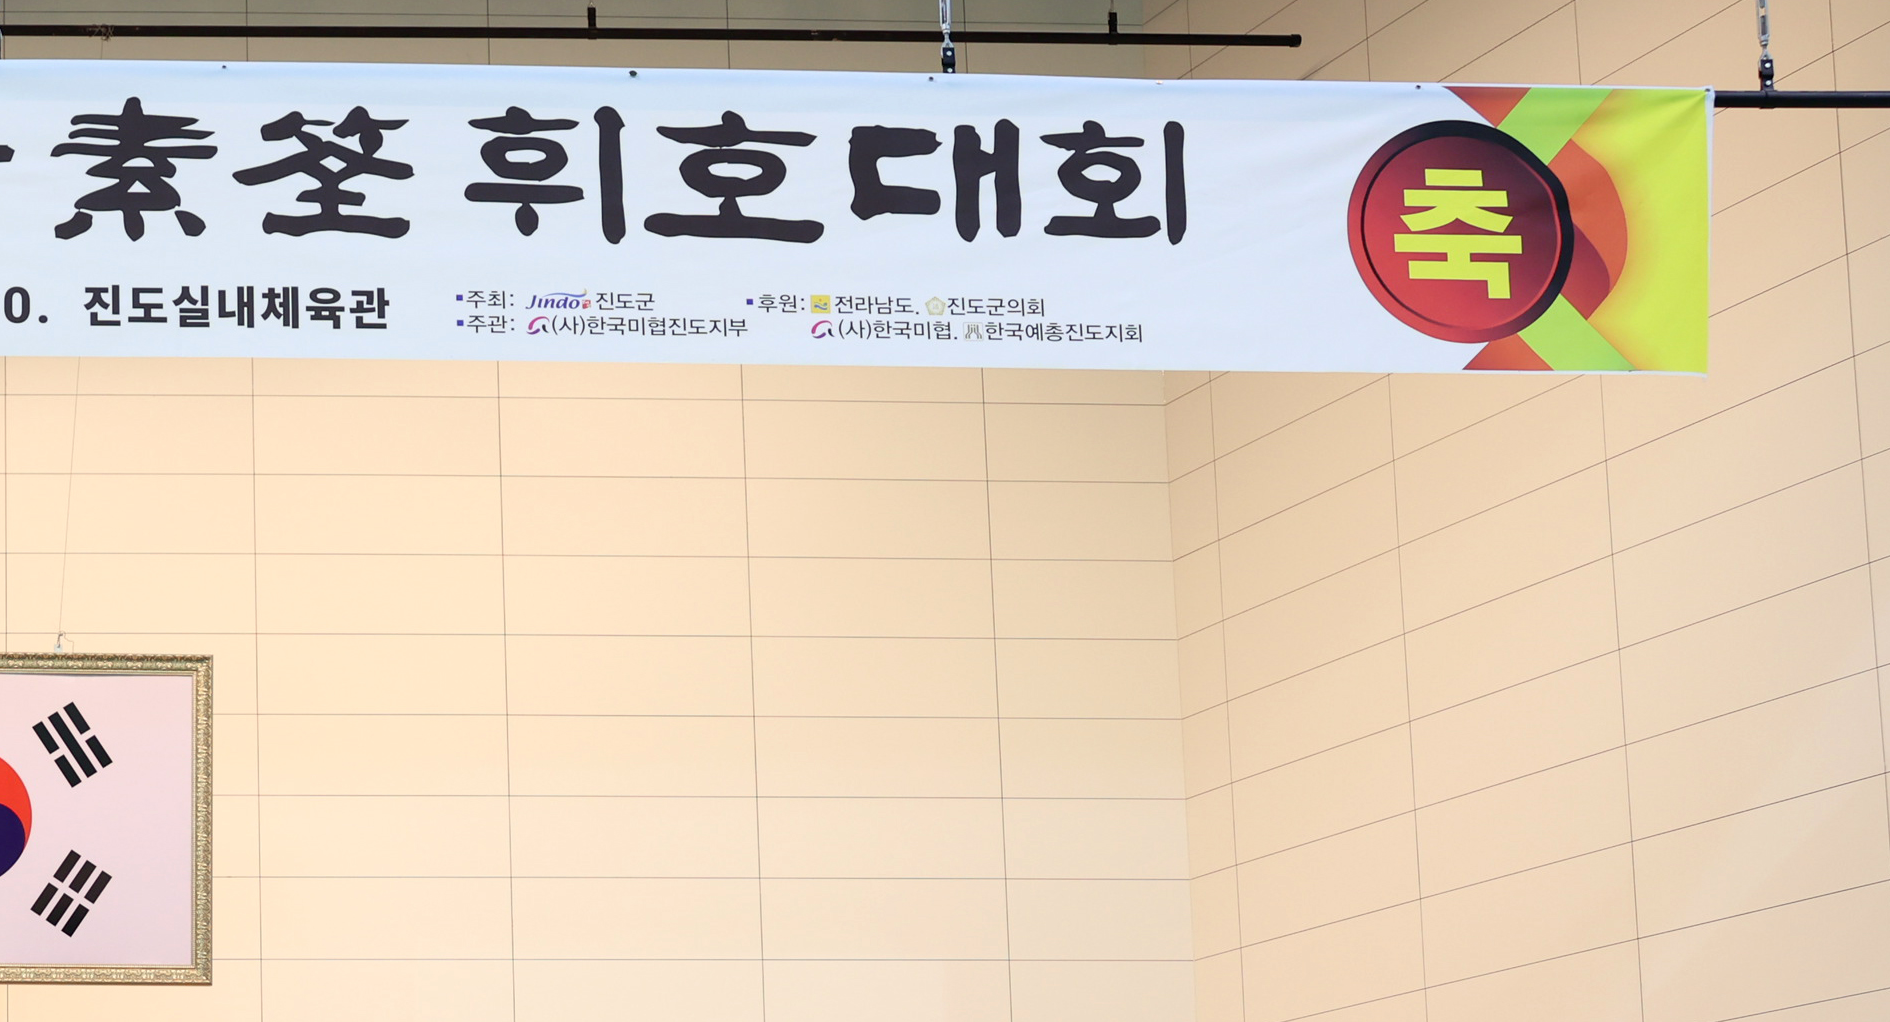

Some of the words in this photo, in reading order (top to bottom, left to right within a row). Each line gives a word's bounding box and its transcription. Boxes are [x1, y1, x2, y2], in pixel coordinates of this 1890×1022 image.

[463, 105, 1188, 246] 휘호대회
[1392, 166, 1524, 300] 축
[83, 284, 391, 330] 진도실내체육관
[466, 290, 515, 310] 주최:
[595, 291, 656, 312] 진도군
[757, 293, 806, 314] 후원:
[947, 297, 1045, 318] 진도군의회
[466, 314, 515, 334] 주관:
[551, 309, 749, 338] (사)한국미협진도지부
[984, 321, 1143, 343] 한국예총진도지회
